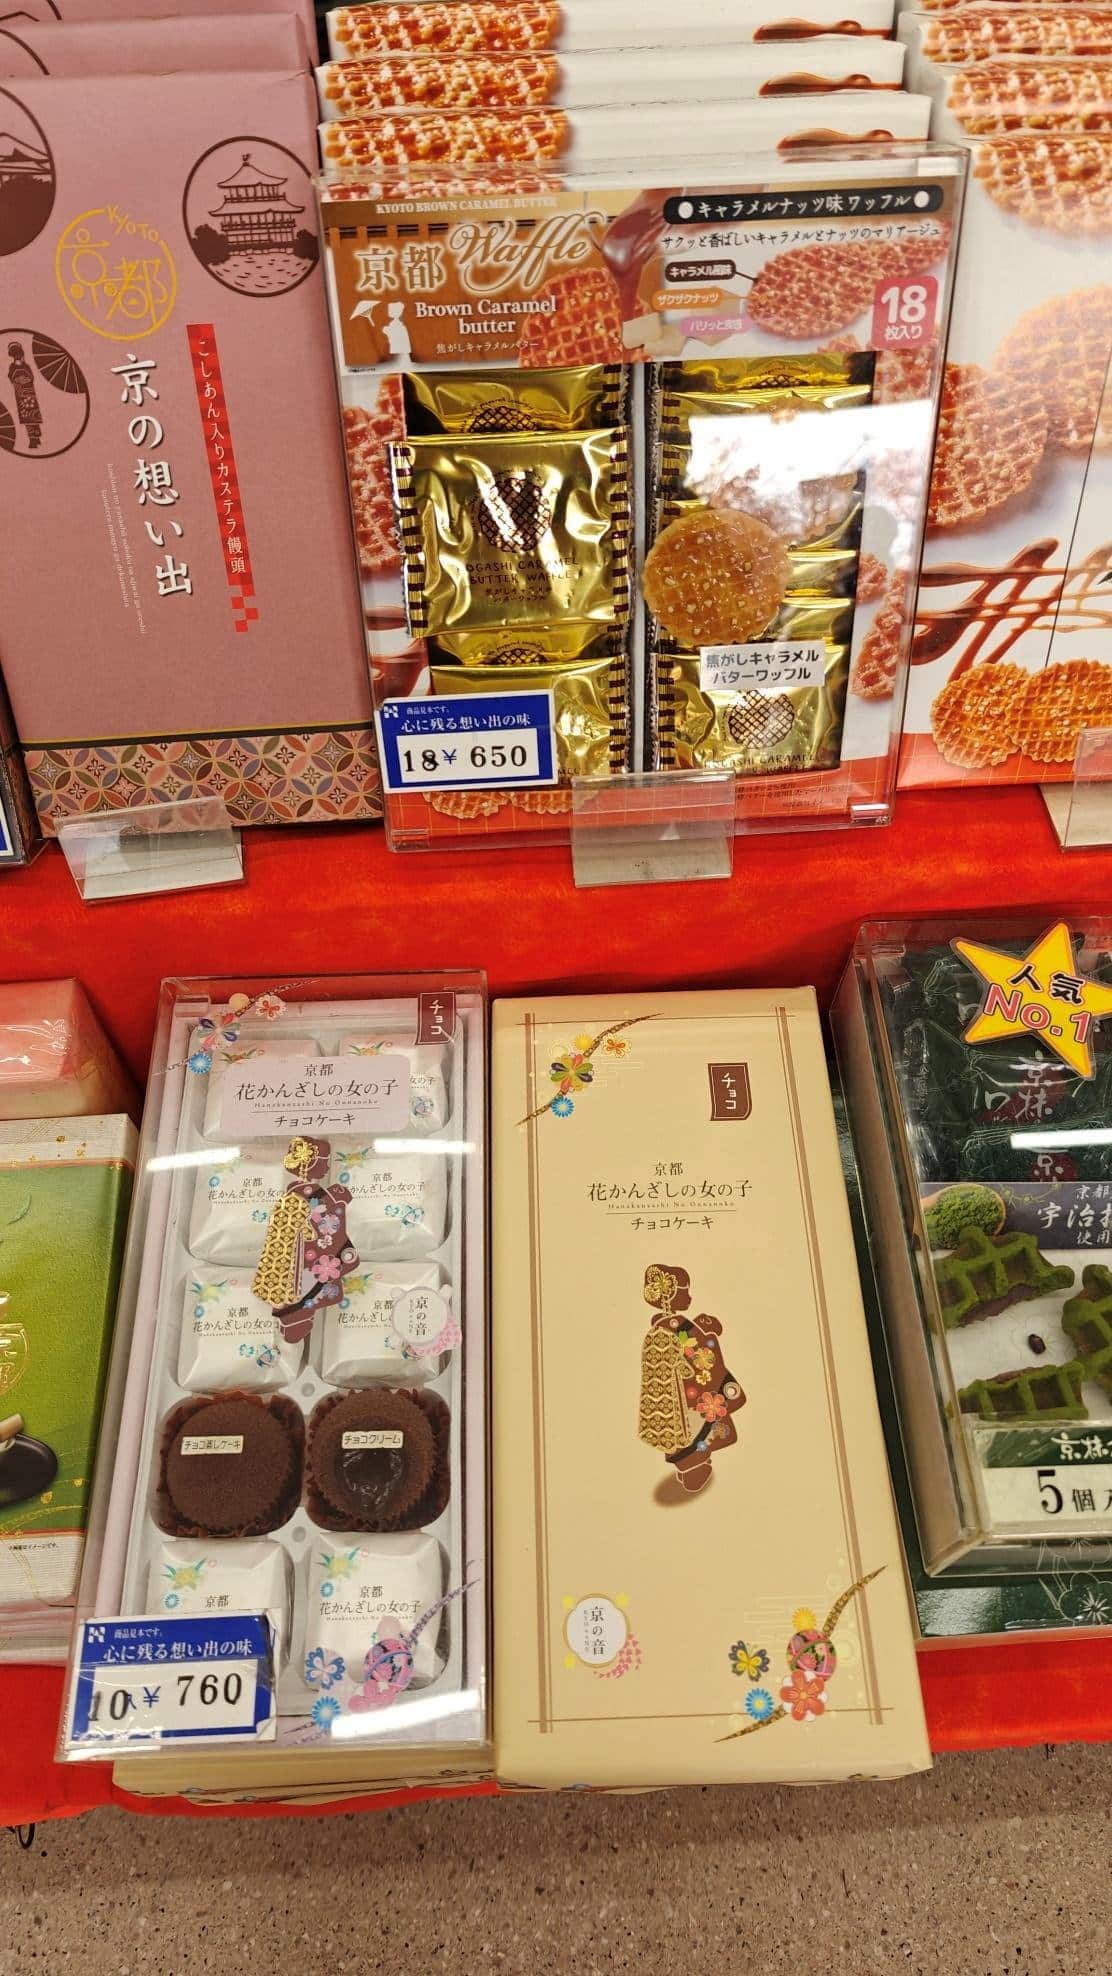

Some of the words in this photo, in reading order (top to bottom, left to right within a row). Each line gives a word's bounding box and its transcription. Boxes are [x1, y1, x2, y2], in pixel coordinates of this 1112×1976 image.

[376, 203, 414, 214] KYOTO
[416, 202, 458, 212] BROWN
[459, 200, 511, 211] CARAMEL
[698, 193, 912, 219] キャラメルナッツ味ワッフル
[106, 205, 161, 244] KYOTO
[660, 222, 941, 249] サクッと香ばしいキャラメルとナッツのマリアージュ
[449, 210, 606, 294] Waffle
[354, 245, 445, 291] 京都
[415, 301, 474, 318] Brown
[477, 295, 557, 315] Caramel
[880, 285, 928, 324] 18
[458, 317, 516, 335] butter
[885, 325, 923, 341] 枚入り
[436, 340, 539, 355] 焦がしキャラメルバター
[197, 338, 246, 574] こしあん入りカステラ饅頭
[111, 352, 194, 597] 京の想い出
[706, 651, 819, 668] 焦がしキャラメル
[713, 667, 811, 685] バターワッフル
[401, 712, 532, 734] 心に残る想い出の味
[442, 748, 457, 765] ¥
[470, 745, 528, 768] 650
[1011, 965, 1086, 1005] 人気
[429, 999, 446, 1036] チョコ
[983, 983, 1092, 1044] No.1
[304, 1063, 335, 1078] 京都
[235, 1078, 400, 1101] 花かんざしの女の子
[720, 1073, 738, 1110] チョコ
[274, 1113, 356, 1128] チョコケーキ
[372, 1172, 393, 1183] 京都
[654, 1161, 684, 1177] 京都
[243, 1176, 264, 1187] 京都
[586, 1179, 753, 1202] 花かんざしの女の子
[630, 1215, 714, 1231] チョコケーキ
[227, 1306, 249, 1318] 京都
[415, 1296, 429, 1337] 京の音
[343, 1433, 402, 1446] チョコクリーム
[204, 1594, 230, 1608] 京都
[359, 1585, 383, 1598] 京都
[319, 1600, 422, 1616] 花かんざしの女の子
[590, 1605, 607, 1656] 京の音
[103, 1638, 253, 1663] 心に残る想い出の味
[142, 1685, 161, 1709] ¥
[176, 1672, 243, 1707] 760
